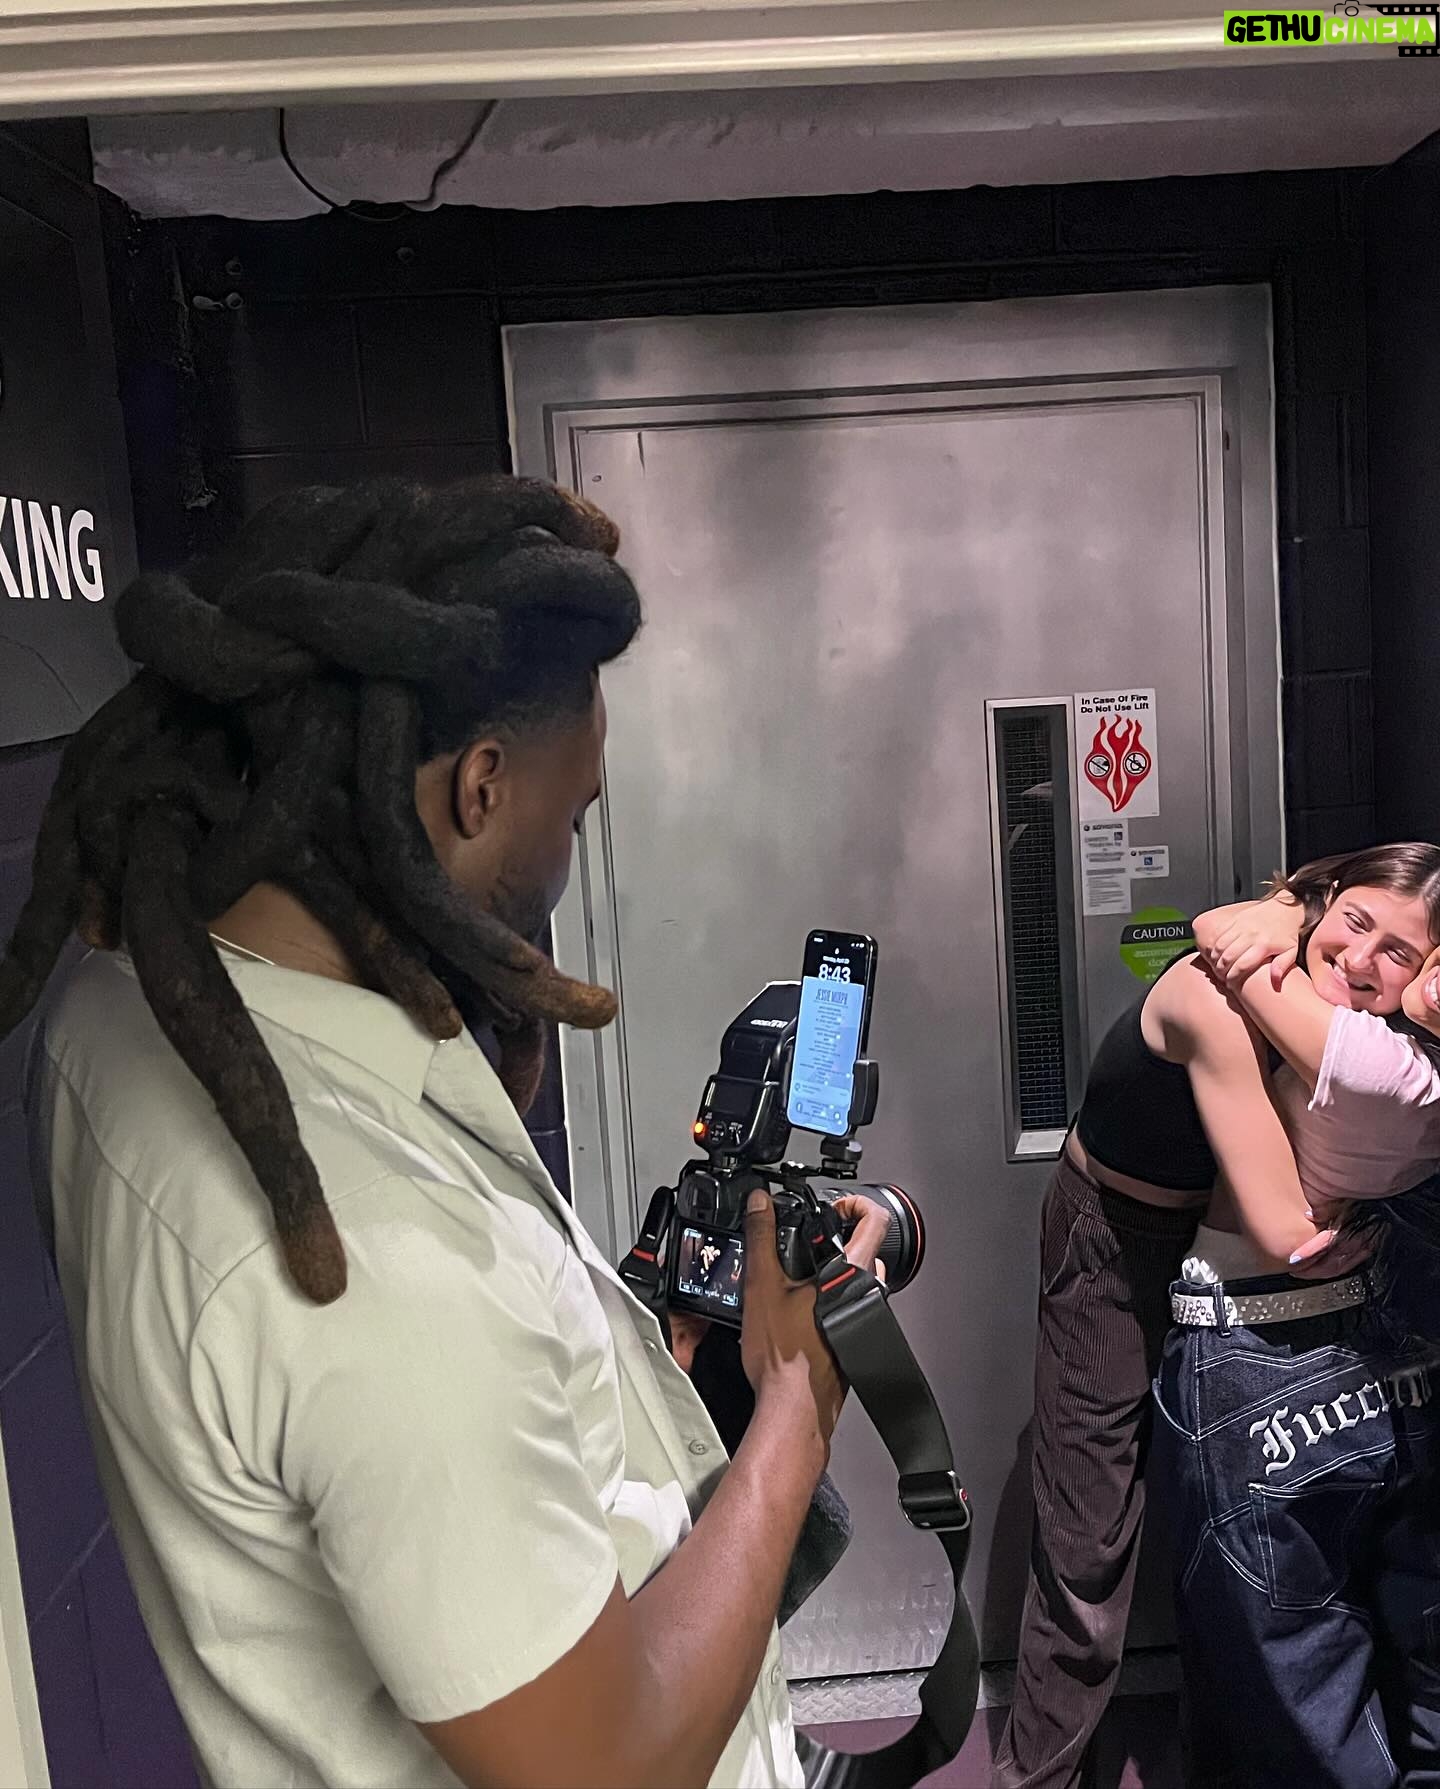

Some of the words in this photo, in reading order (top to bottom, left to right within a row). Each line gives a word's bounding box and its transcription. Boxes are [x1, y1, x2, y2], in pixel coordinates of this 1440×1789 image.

[1081, 697, 1091, 705] In
[1118, 695, 1129, 703] Of
[1131, 694, 1148, 702] Fire
[1095, 705, 1112, 713] Not
[1132, 926, 1185, 940] CAUTION
[818, 963, 851, 985] 8:43
